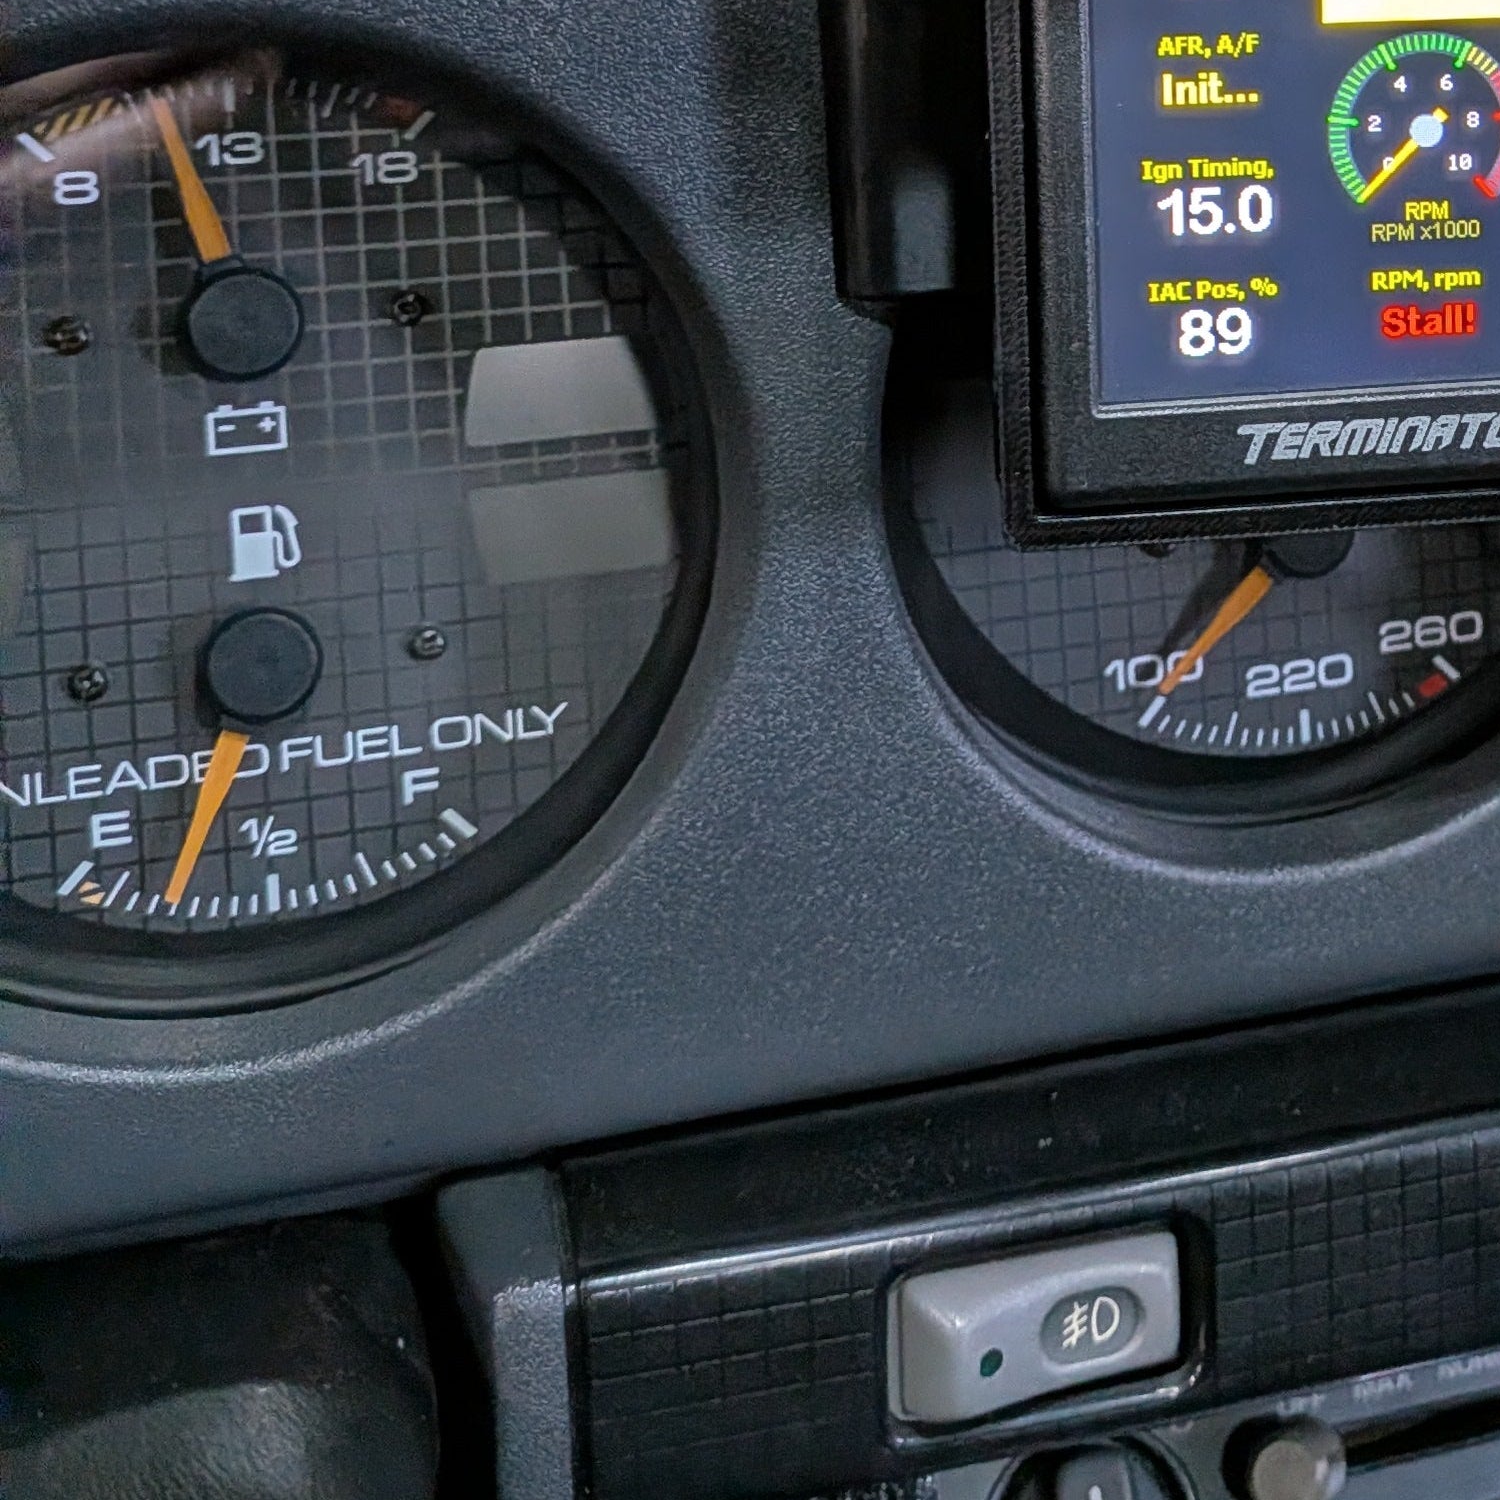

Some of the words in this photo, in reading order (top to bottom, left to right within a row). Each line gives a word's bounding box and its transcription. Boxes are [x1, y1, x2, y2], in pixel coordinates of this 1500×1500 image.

[1158, 35, 1212, 58] AFR,
[1216, 32, 1260, 57] A/F
[1161, 72, 1259, 106] Init...
[1393, 76, 1408, 92] 4
[1440, 74, 1454, 91] 6
[1367, 115, 1382, 132] 2
[1466, 111, 1480, 128] 8
[194, 132, 265, 166] 13
[1448, 153, 1473, 171] 10
[352, 151, 419, 185] 18
[1142, 160, 1183, 184] Ign
[1187, 157, 1274, 180] Timing,
[54, 171, 99, 206] 8
[1157, 184, 1273, 236] 15.0
[1405, 200, 1450, 221] RPM
[1371, 222, 1415, 242] RPM
[1420, 219, 1481, 240] x1000
[1148, 282, 1192, 303] IAC
[1197, 280, 1245, 301] Pos,
[1250, 277, 1278, 297] %
[1372, 270, 1429, 292] RPM,
[1434, 271, 1481, 291] rpm
[1179, 306, 1252, 357] 89
[1382, 303, 1477, 339] Stall!
[1379, 610, 1484, 654] 260
[1103, 651, 1204, 692] 100
[1246, 653, 1355, 698] 220
[280, 724, 424, 773] FUEL
[430, 701, 570, 752] ONLY
[403, 767, 440, 805] F
[91, 809, 133, 849] E
